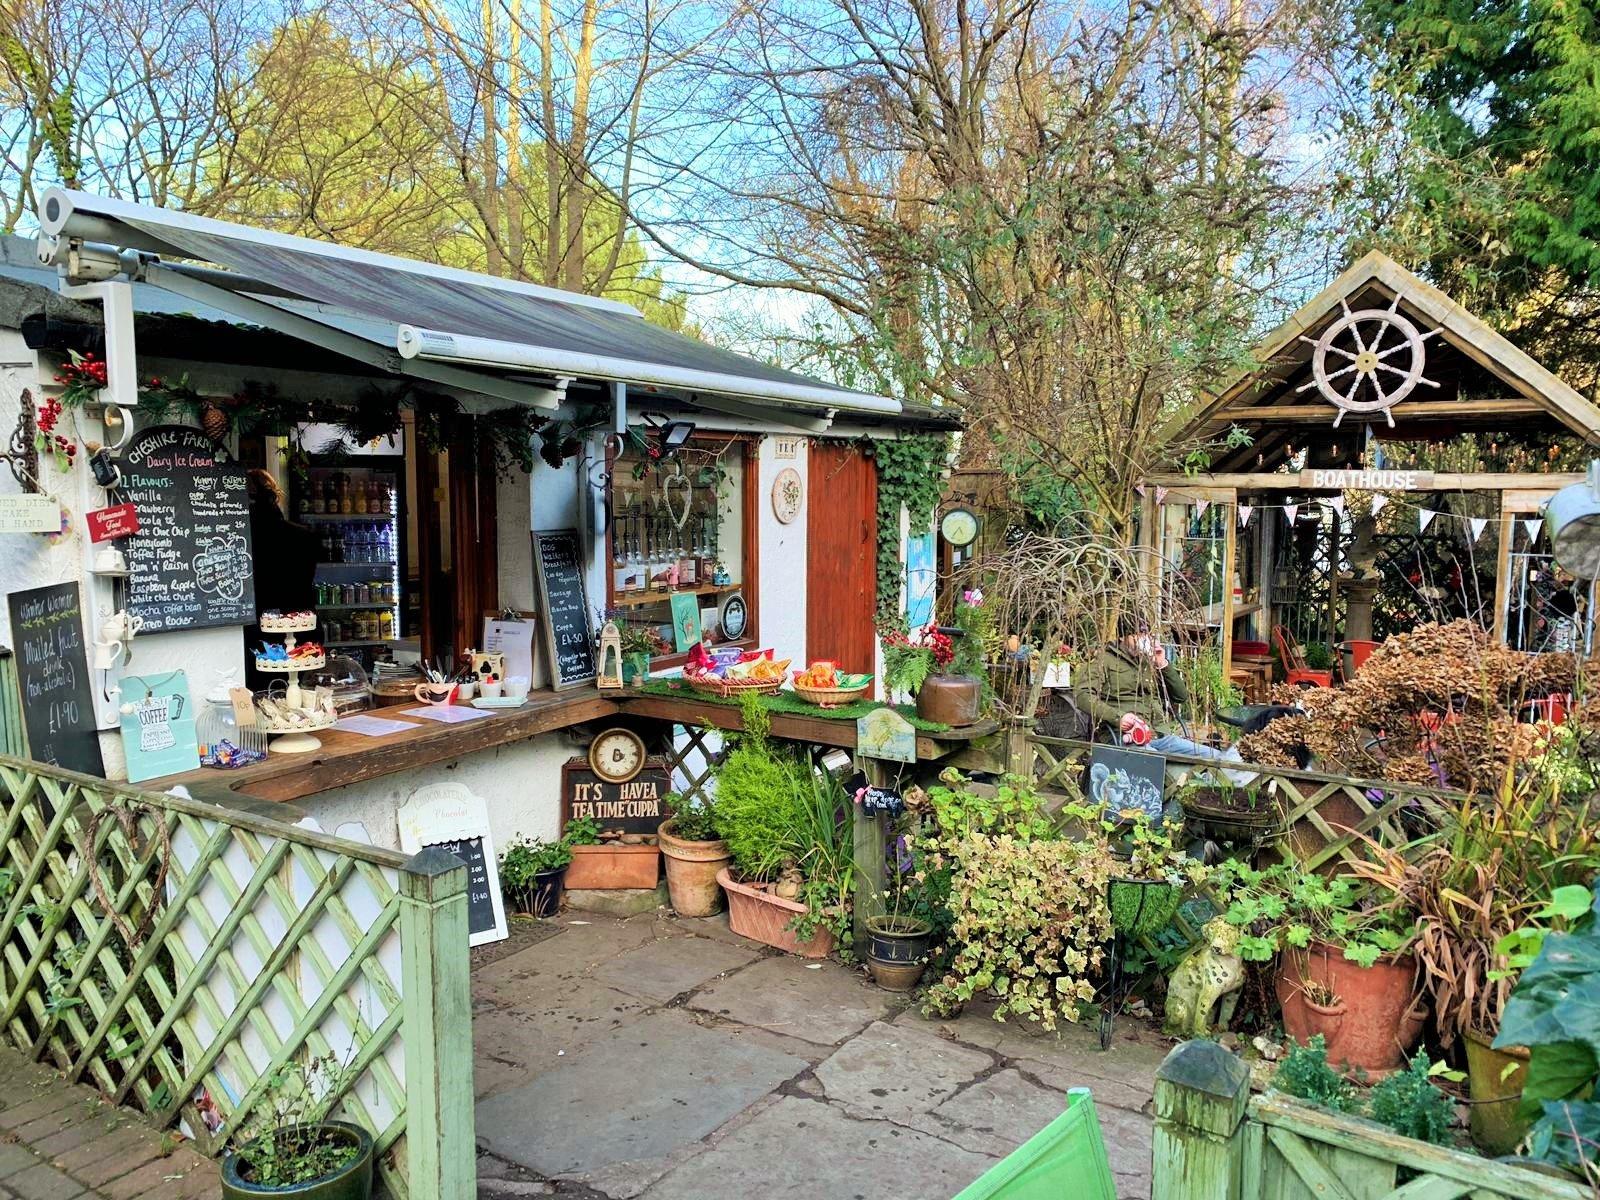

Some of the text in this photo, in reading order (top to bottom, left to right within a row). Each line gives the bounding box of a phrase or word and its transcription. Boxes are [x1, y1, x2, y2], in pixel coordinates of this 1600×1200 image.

[128, 432, 214, 464] CHESHIRE FARM
[147, 455, 172, 471] Dairy
[175, 453, 186, 467] Ice
[1312, 470, 1418, 490] BOATHOUSE
[127, 489, 162, 502] Vanilla
[134, 504, 176, 518] rawberry
[128, 538, 172, 550] Honeycomb
[126, 548, 181, 562] Toffee Fudge
[130, 561, 148, 572] Rum
[162, 560, 189, 572] Raisin
[130, 574, 160, 584] Banana
[130, 578, 196, 594] Raspberry Ripple
[130, 594, 152, 604] White
[131, 606, 161, 618] Mocha
[139, 708, 168, 726] COFFEE
[574, 782, 602, 800] IT'S
[572, 801, 596, 818] TEA
[596, 801, 626, 818] TIME
